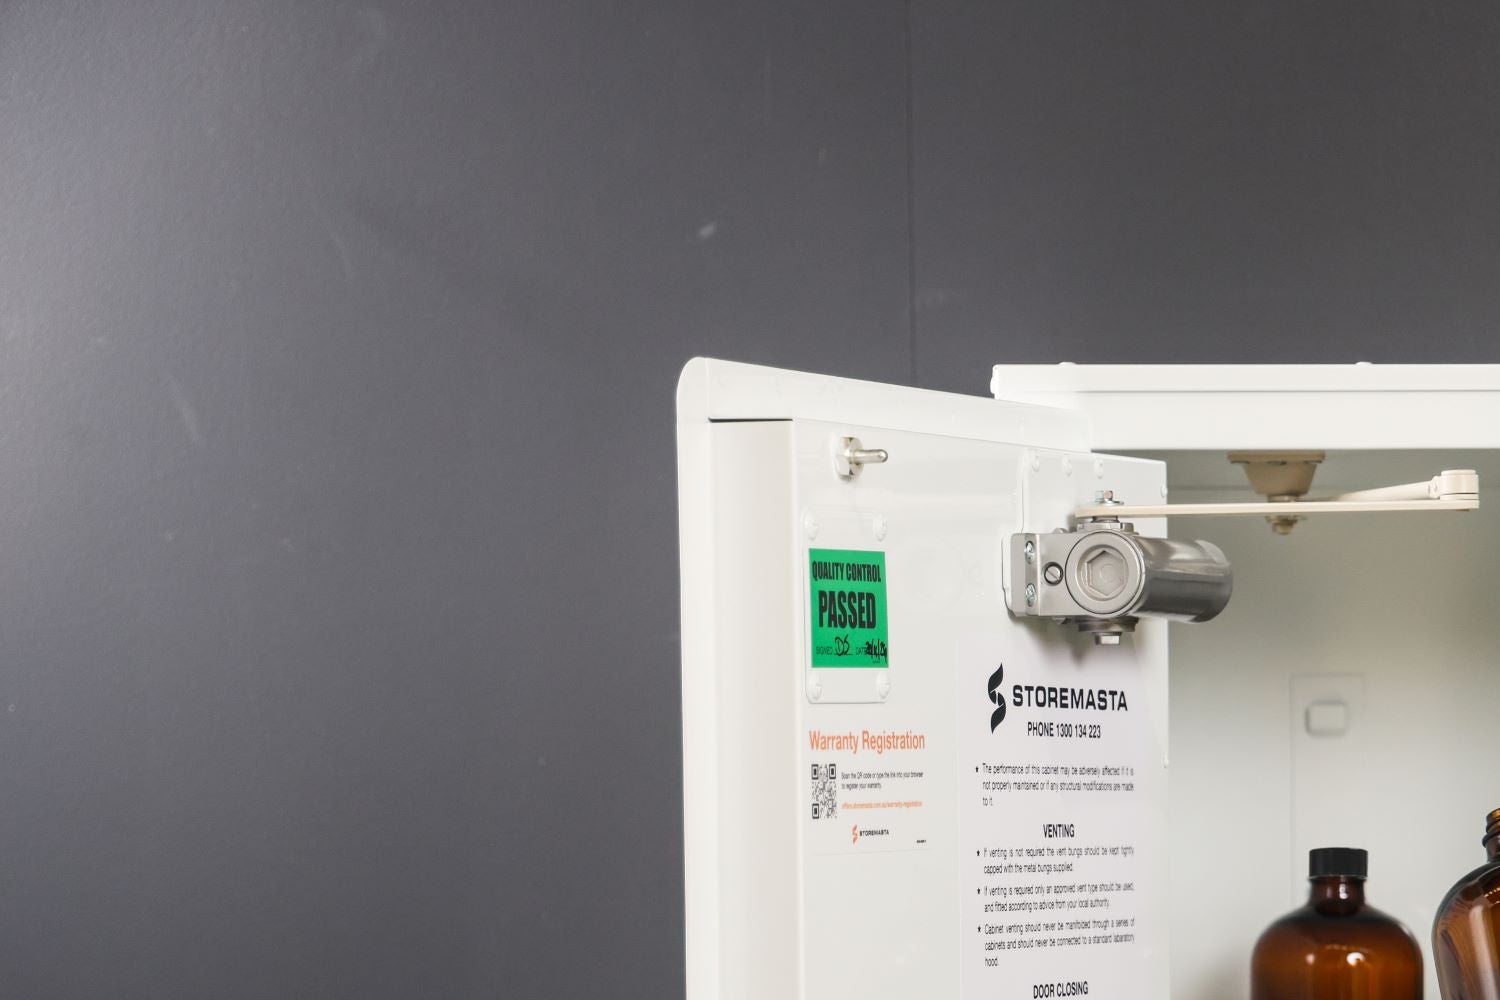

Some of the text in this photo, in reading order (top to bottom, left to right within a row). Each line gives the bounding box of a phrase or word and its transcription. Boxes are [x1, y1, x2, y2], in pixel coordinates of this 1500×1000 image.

[812, 561, 881, 582] QUALITY CONTROL
[818, 590, 876, 629] PASSED
[1012, 684, 1128, 711] STOREMASTA
[1027, 721, 1101, 739] PHONE 1300 134 223
[809, 730, 925, 754] Warranty Registration
[1043, 824, 1075, 838] VENTING
[1033, 981, 1088, 999] DOOR CLOSING
